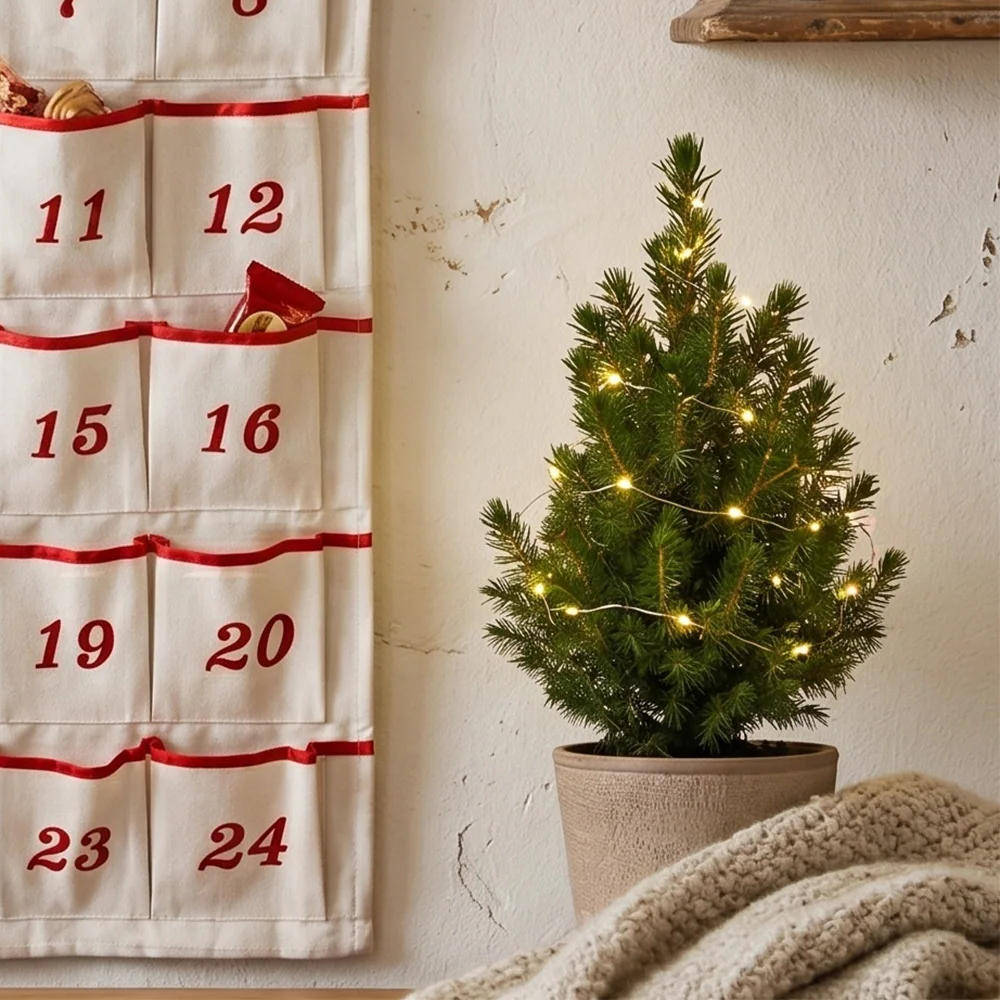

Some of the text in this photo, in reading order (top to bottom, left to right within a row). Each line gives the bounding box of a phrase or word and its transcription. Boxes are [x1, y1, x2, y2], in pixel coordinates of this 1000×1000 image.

[36, 189, 107, 245] 11
[204, 179, 285, 235] 12
[32, 403, 112, 459] 15
[201, 401, 283, 455] 16
[35, 618, 115, 670] 19
[205, 612, 296, 671] 20
[27, 825, 111, 872] 23
[199, 816, 288, 872] 24
